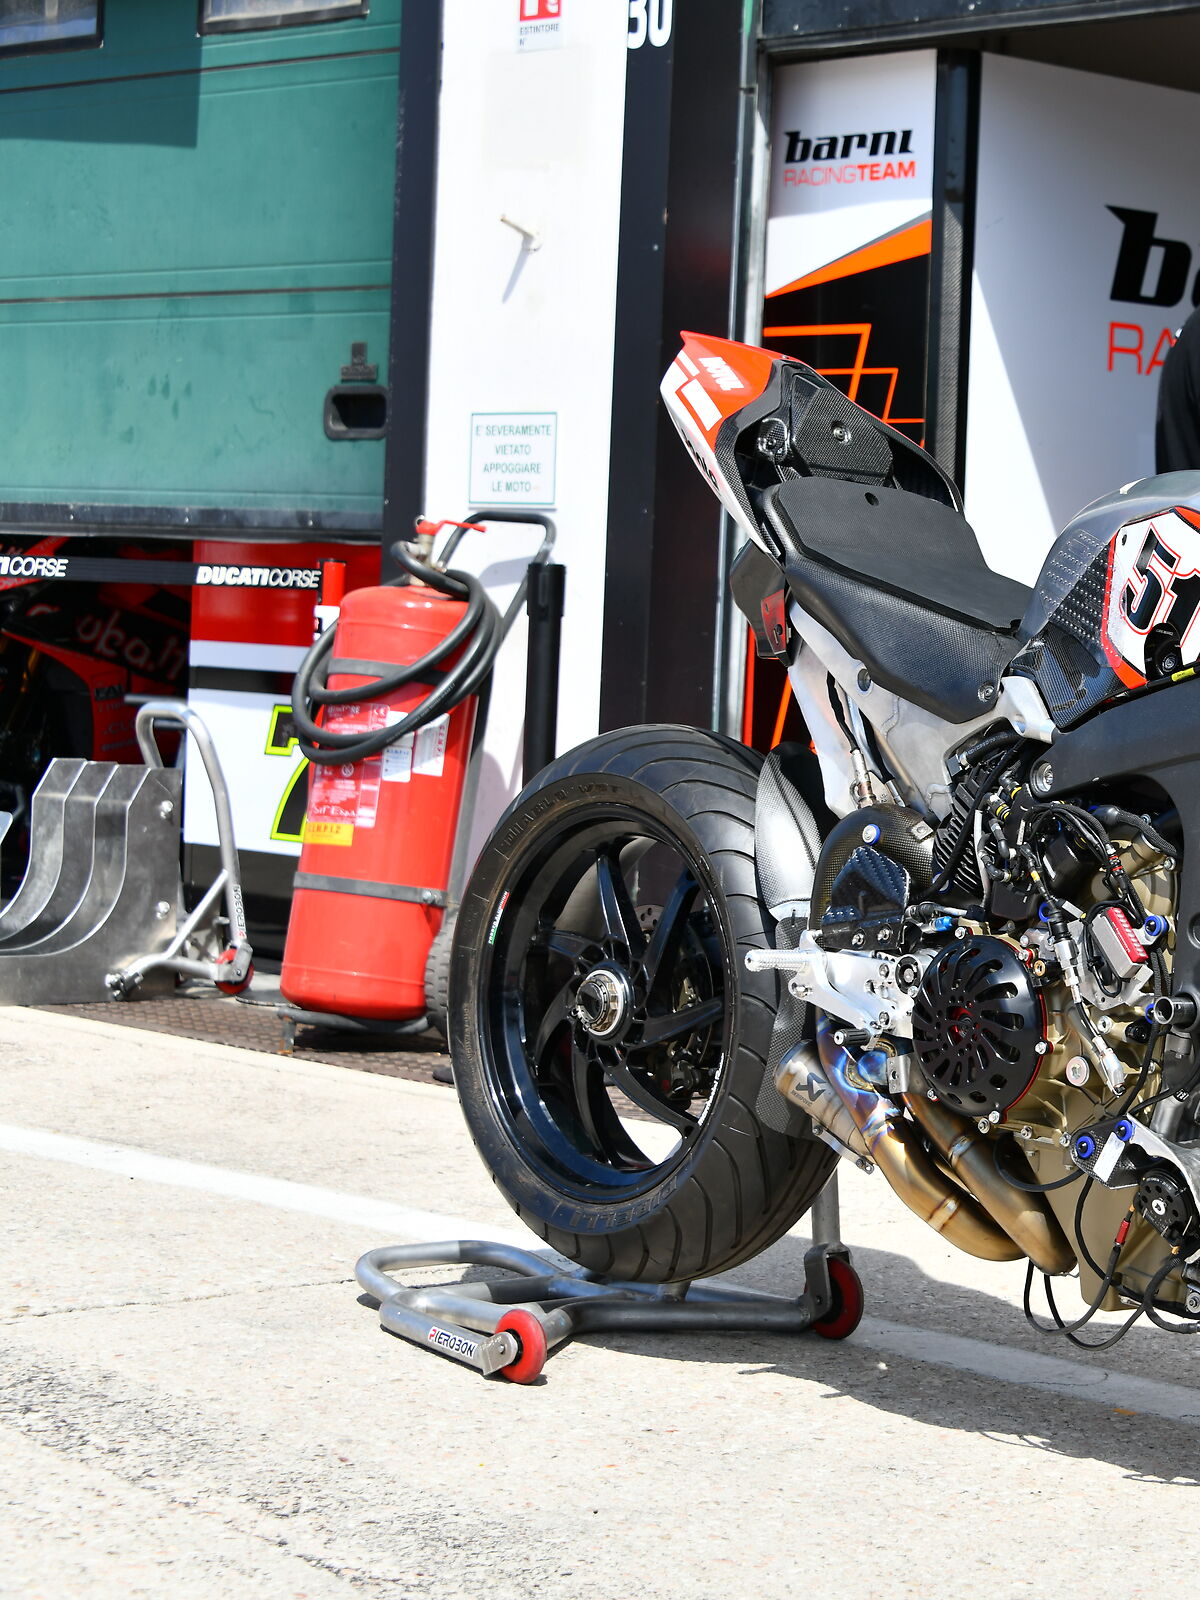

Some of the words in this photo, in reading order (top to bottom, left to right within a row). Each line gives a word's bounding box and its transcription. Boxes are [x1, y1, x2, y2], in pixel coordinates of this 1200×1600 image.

[519, 23, 560, 36] ESTINTORE
[784, 130, 914, 164] barni
[784, 160, 916, 187] RACINGTEAM
[486, 423, 552, 436] SEVERAMENTE
[495, 443, 532, 456] VIETATO
[483, 462, 542, 474] APPOGGIARE
[492, 480, 503, 492] LE
[505, 480, 532, 492] MOTO
[196, 565, 322, 588] DUCATICORSE
[428, 1328, 476, 1357] PIEROBON
